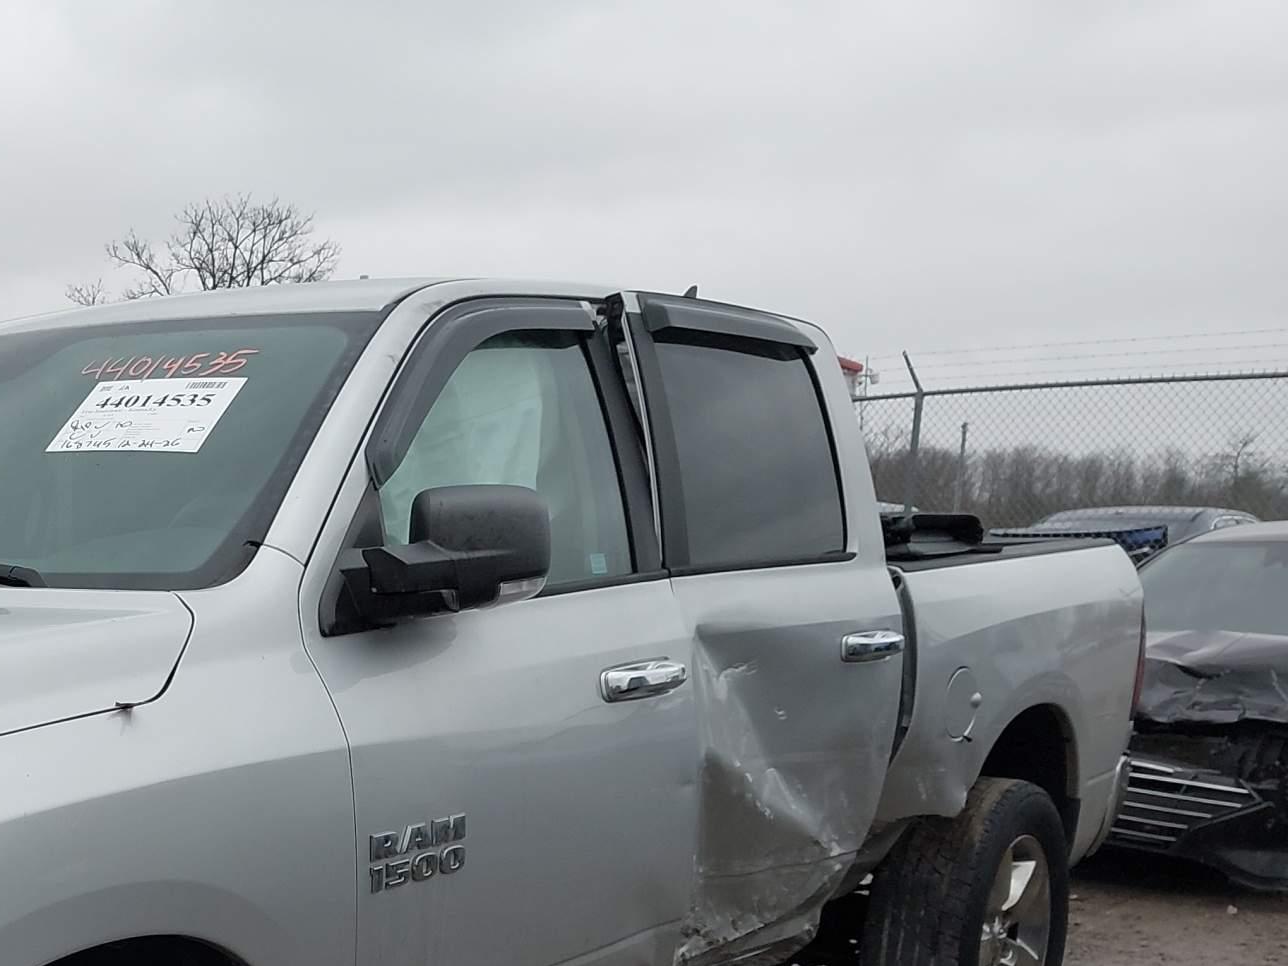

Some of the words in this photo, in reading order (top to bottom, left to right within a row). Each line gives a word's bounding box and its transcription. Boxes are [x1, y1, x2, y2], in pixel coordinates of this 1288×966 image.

[81, 348, 260, 383] 44014535
[95, 393, 217, 409] 44014535
[369, 812, 466, 862] RAM
[369, 844, 466, 894] 1500
